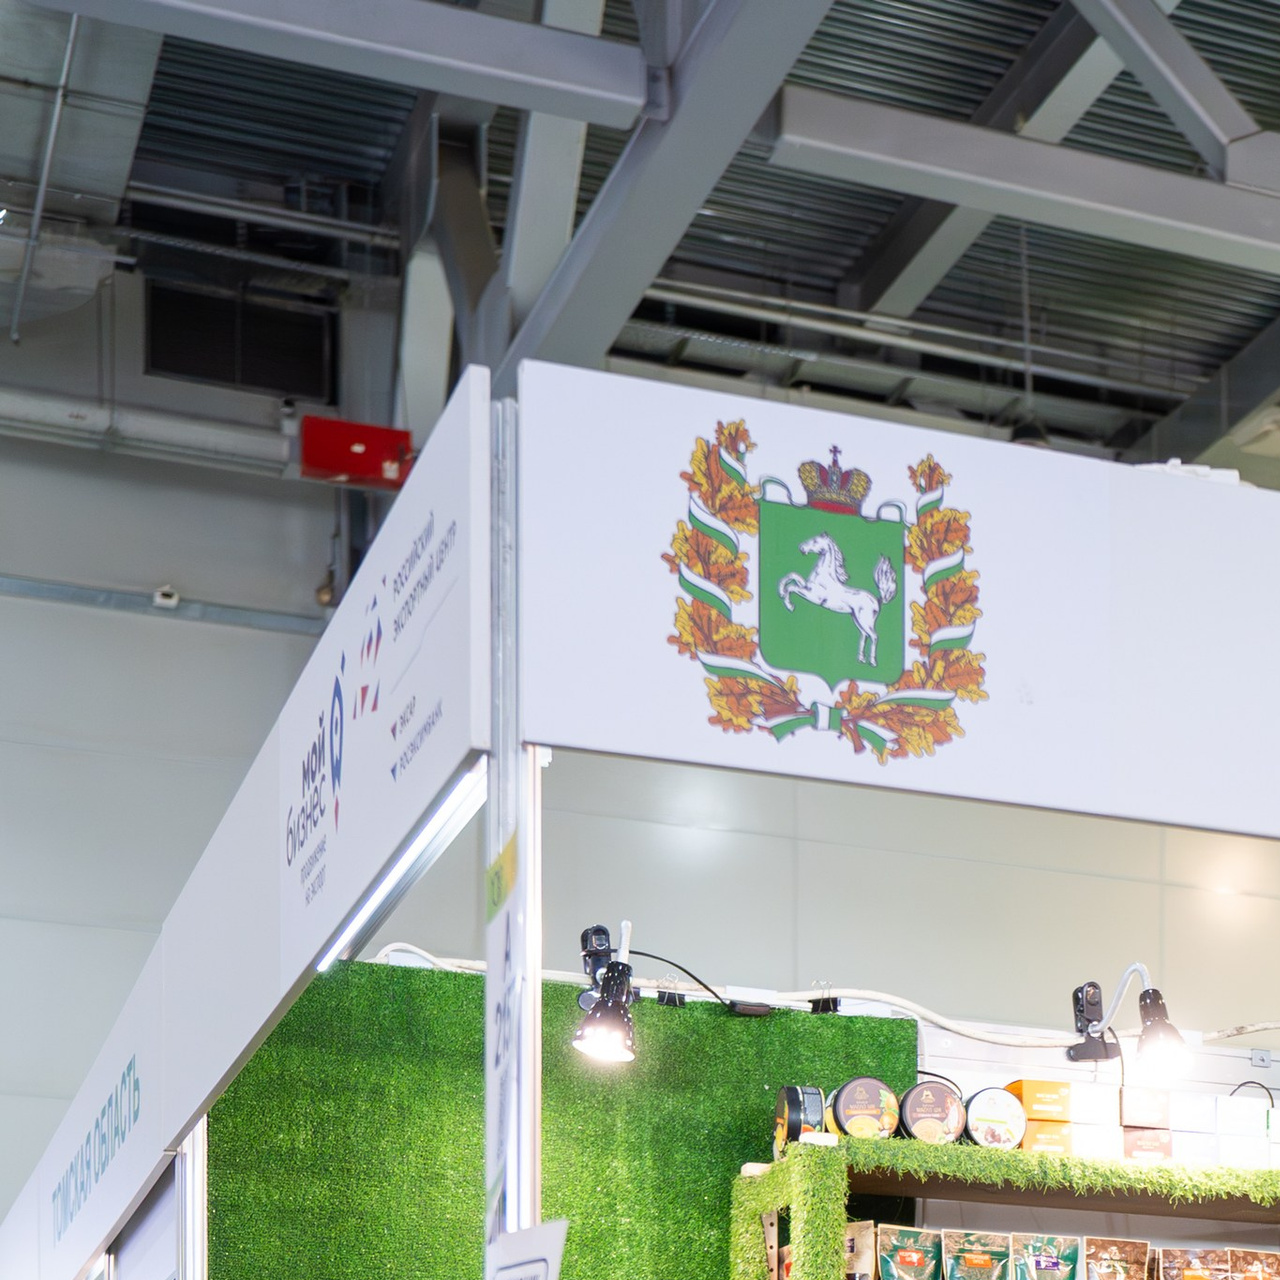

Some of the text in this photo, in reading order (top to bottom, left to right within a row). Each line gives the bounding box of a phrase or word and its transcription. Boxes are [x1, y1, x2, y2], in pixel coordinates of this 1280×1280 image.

[392, 510, 435, 603] РОССИЙСКИЙ
[393, 519, 457, 642] ЭКСПОРТНЫЙ ЦЕНТР
[302, 710, 326, 800] мой
[286, 773, 327, 868] бизнес
[52, 1053, 141, 1249] ТОМСКАЯ ОБЛАСТЬ
